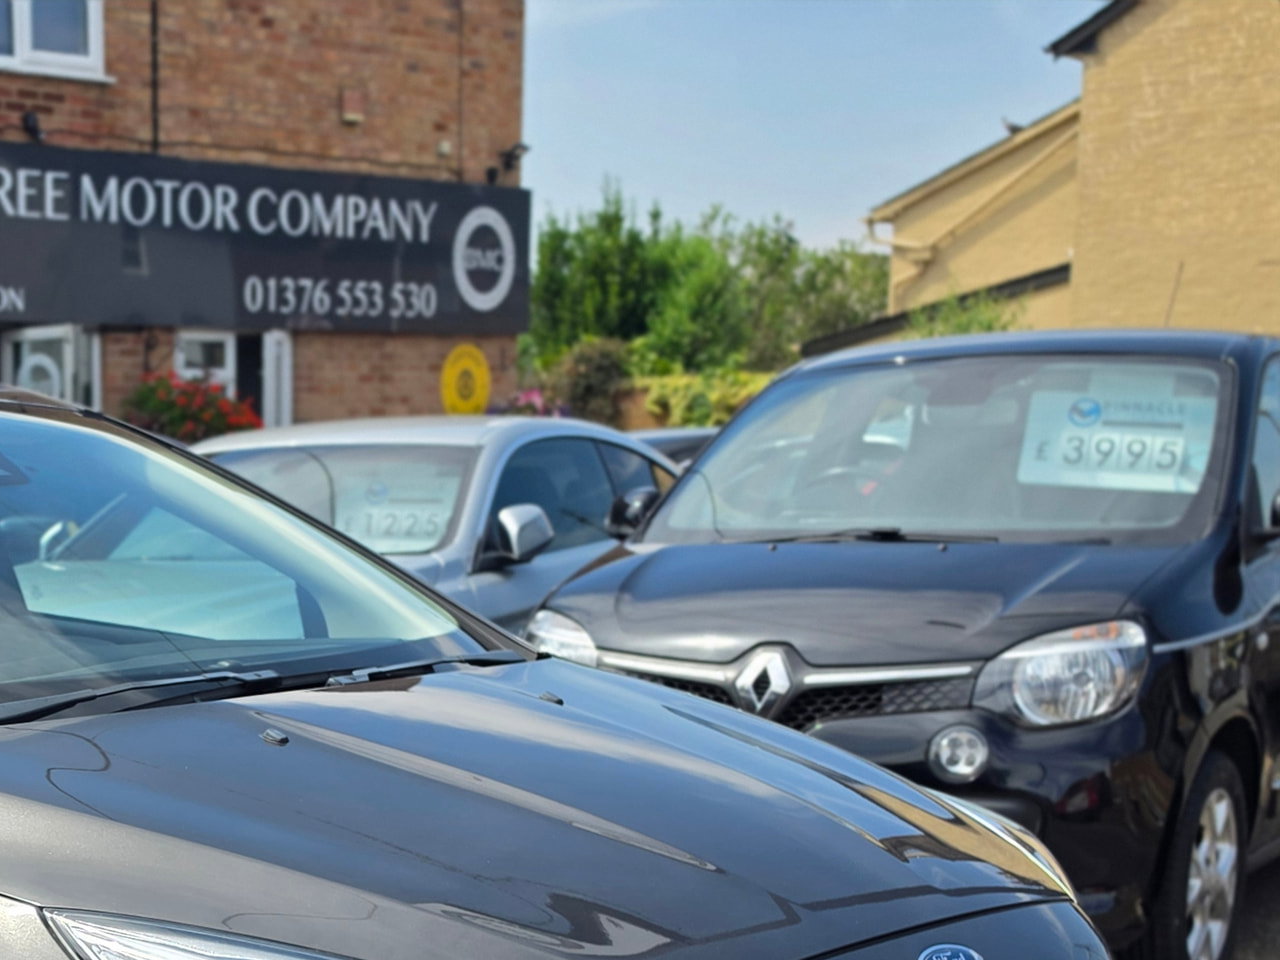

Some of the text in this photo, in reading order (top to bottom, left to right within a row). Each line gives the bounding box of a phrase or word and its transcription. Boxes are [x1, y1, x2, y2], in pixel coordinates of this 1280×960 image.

[80, 173, 240, 231] MOTOR
[246, 187, 438, 243] COMPANY
[243, 275, 438, 319] 01376 553 530
